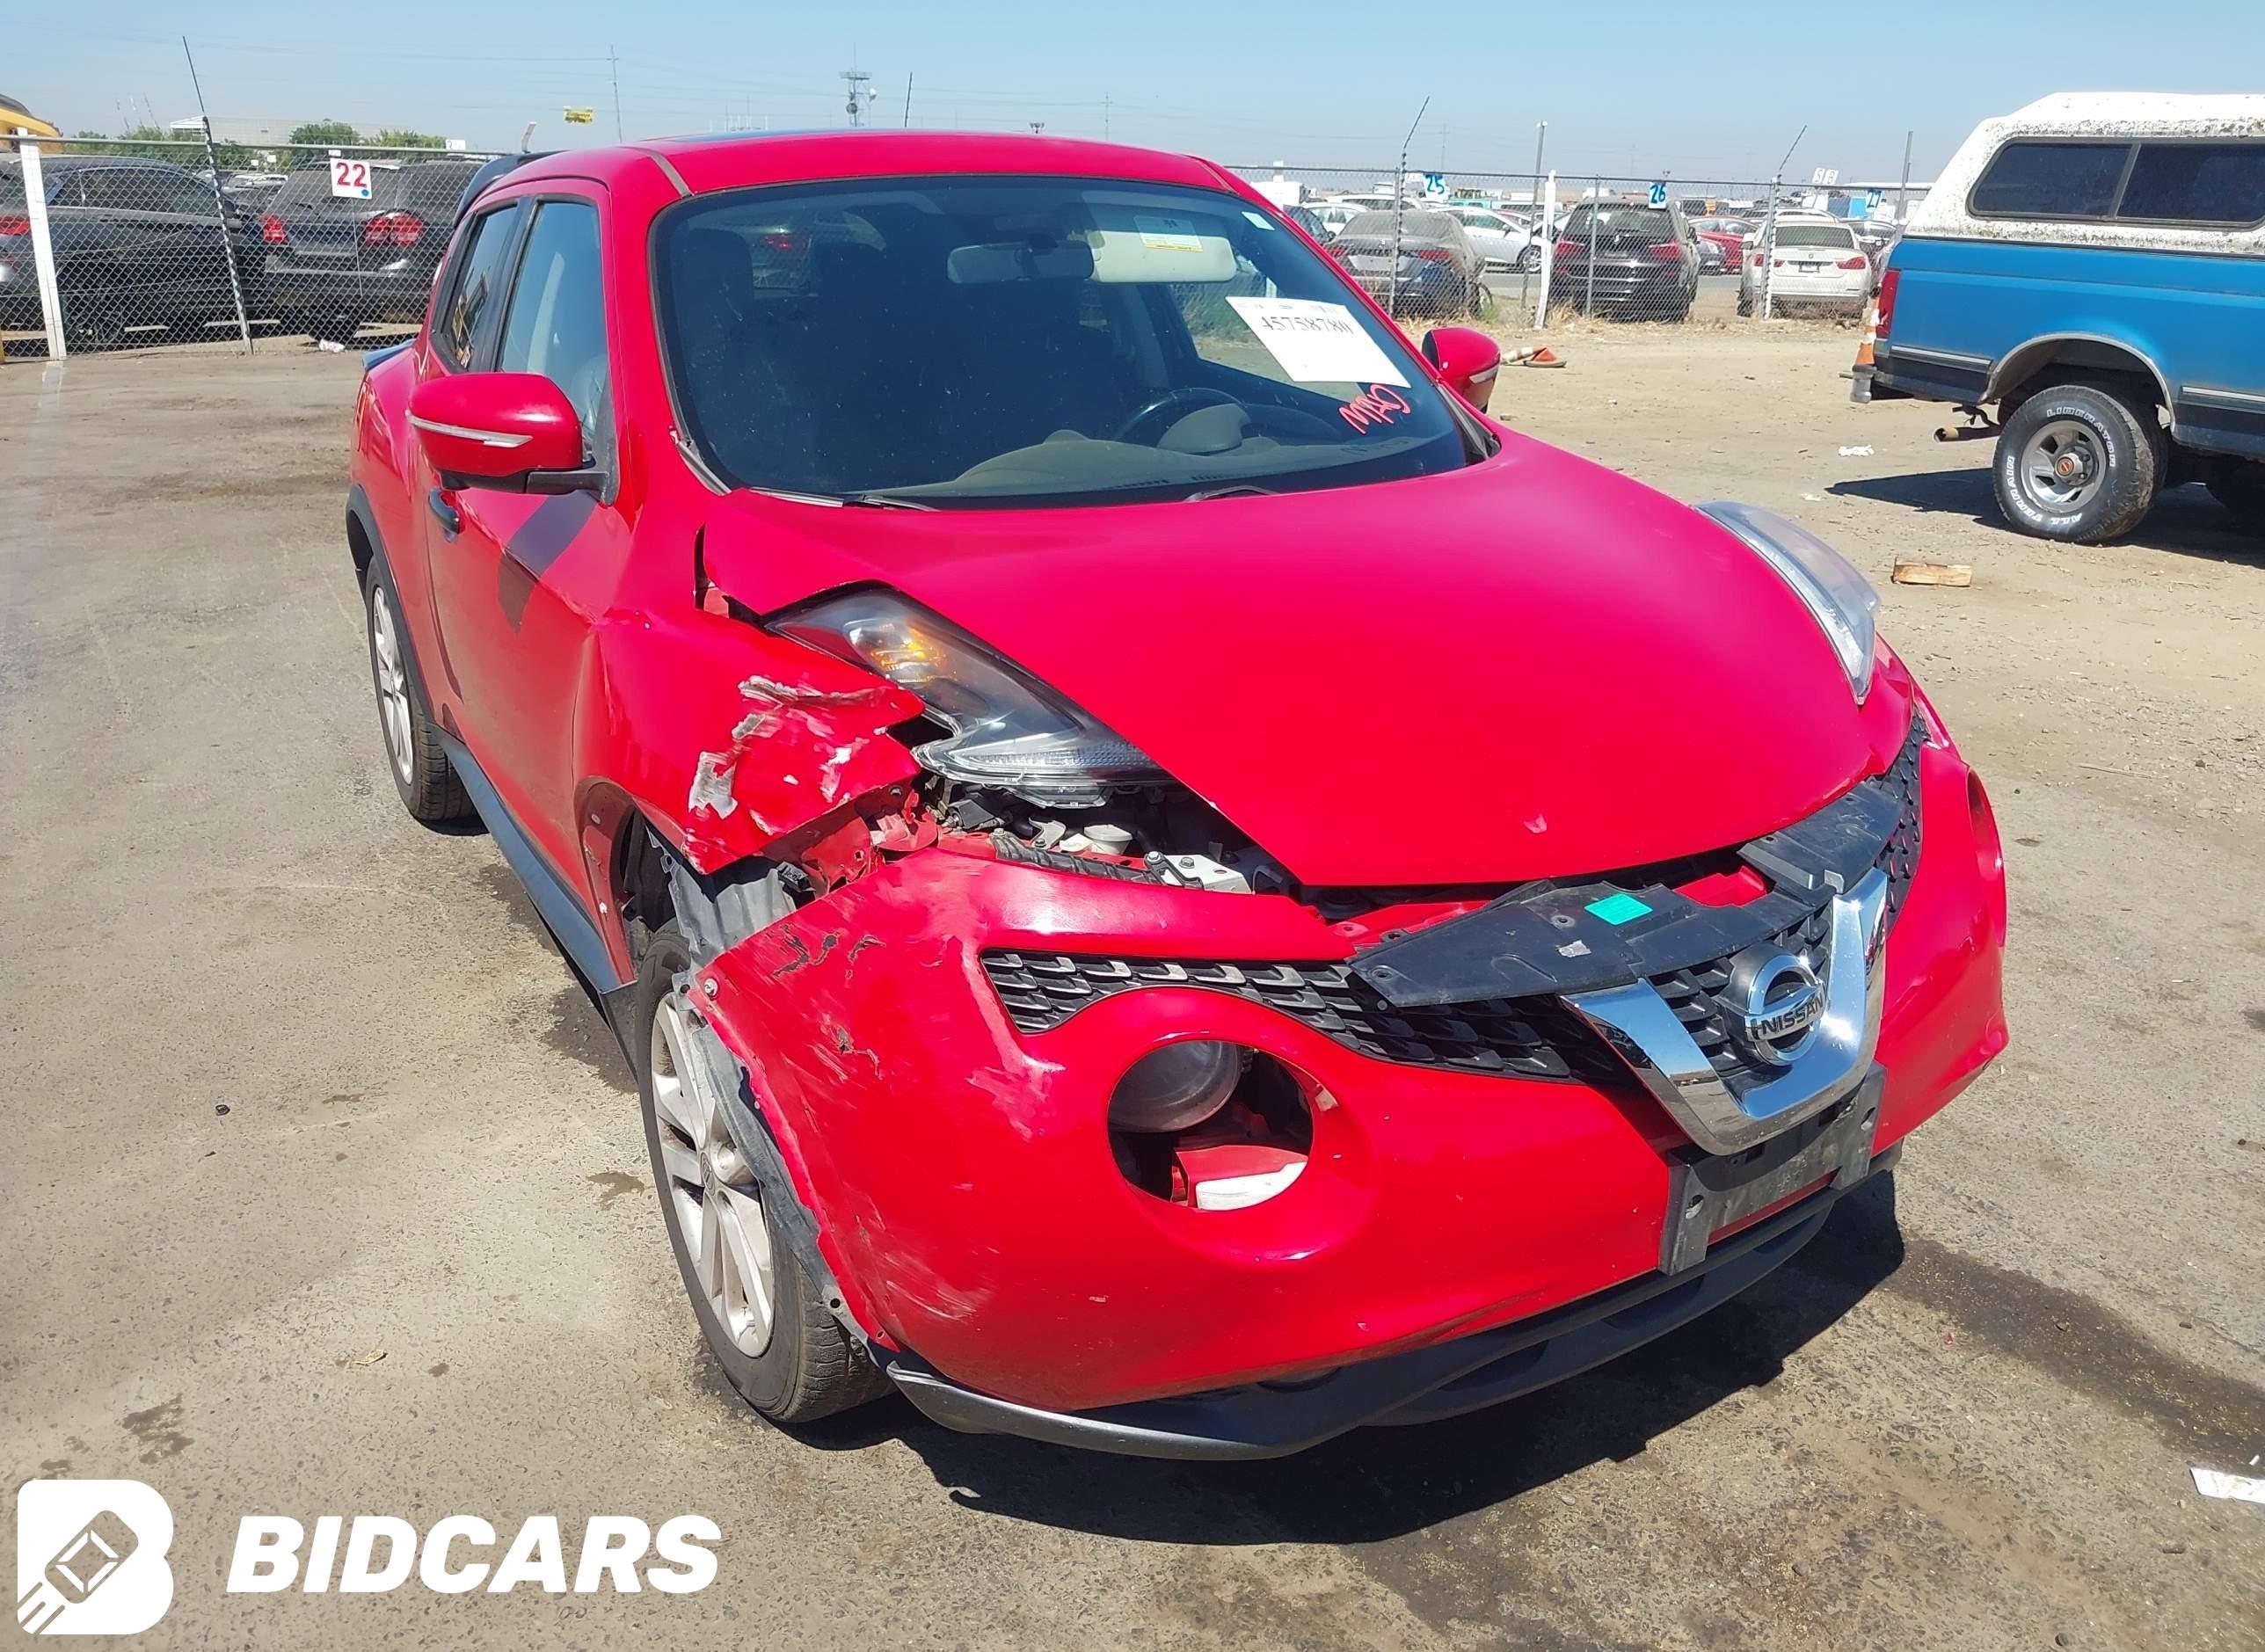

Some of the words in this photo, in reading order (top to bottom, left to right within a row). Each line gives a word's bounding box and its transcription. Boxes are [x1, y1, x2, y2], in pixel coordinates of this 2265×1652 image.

[336, 162, 368, 188] 22
[1424, 173, 1445, 195] 25
[1650, 181, 1666, 204] 26
[1866, 187, 1882, 208] 27
[2046, 406, 2116, 468] LIBERATOR
[2006, 455, 2043, 522] TERRAIN
[2050, 513, 2083, 525] ALL
[1760, 993, 1824, 1035] NISSAN
